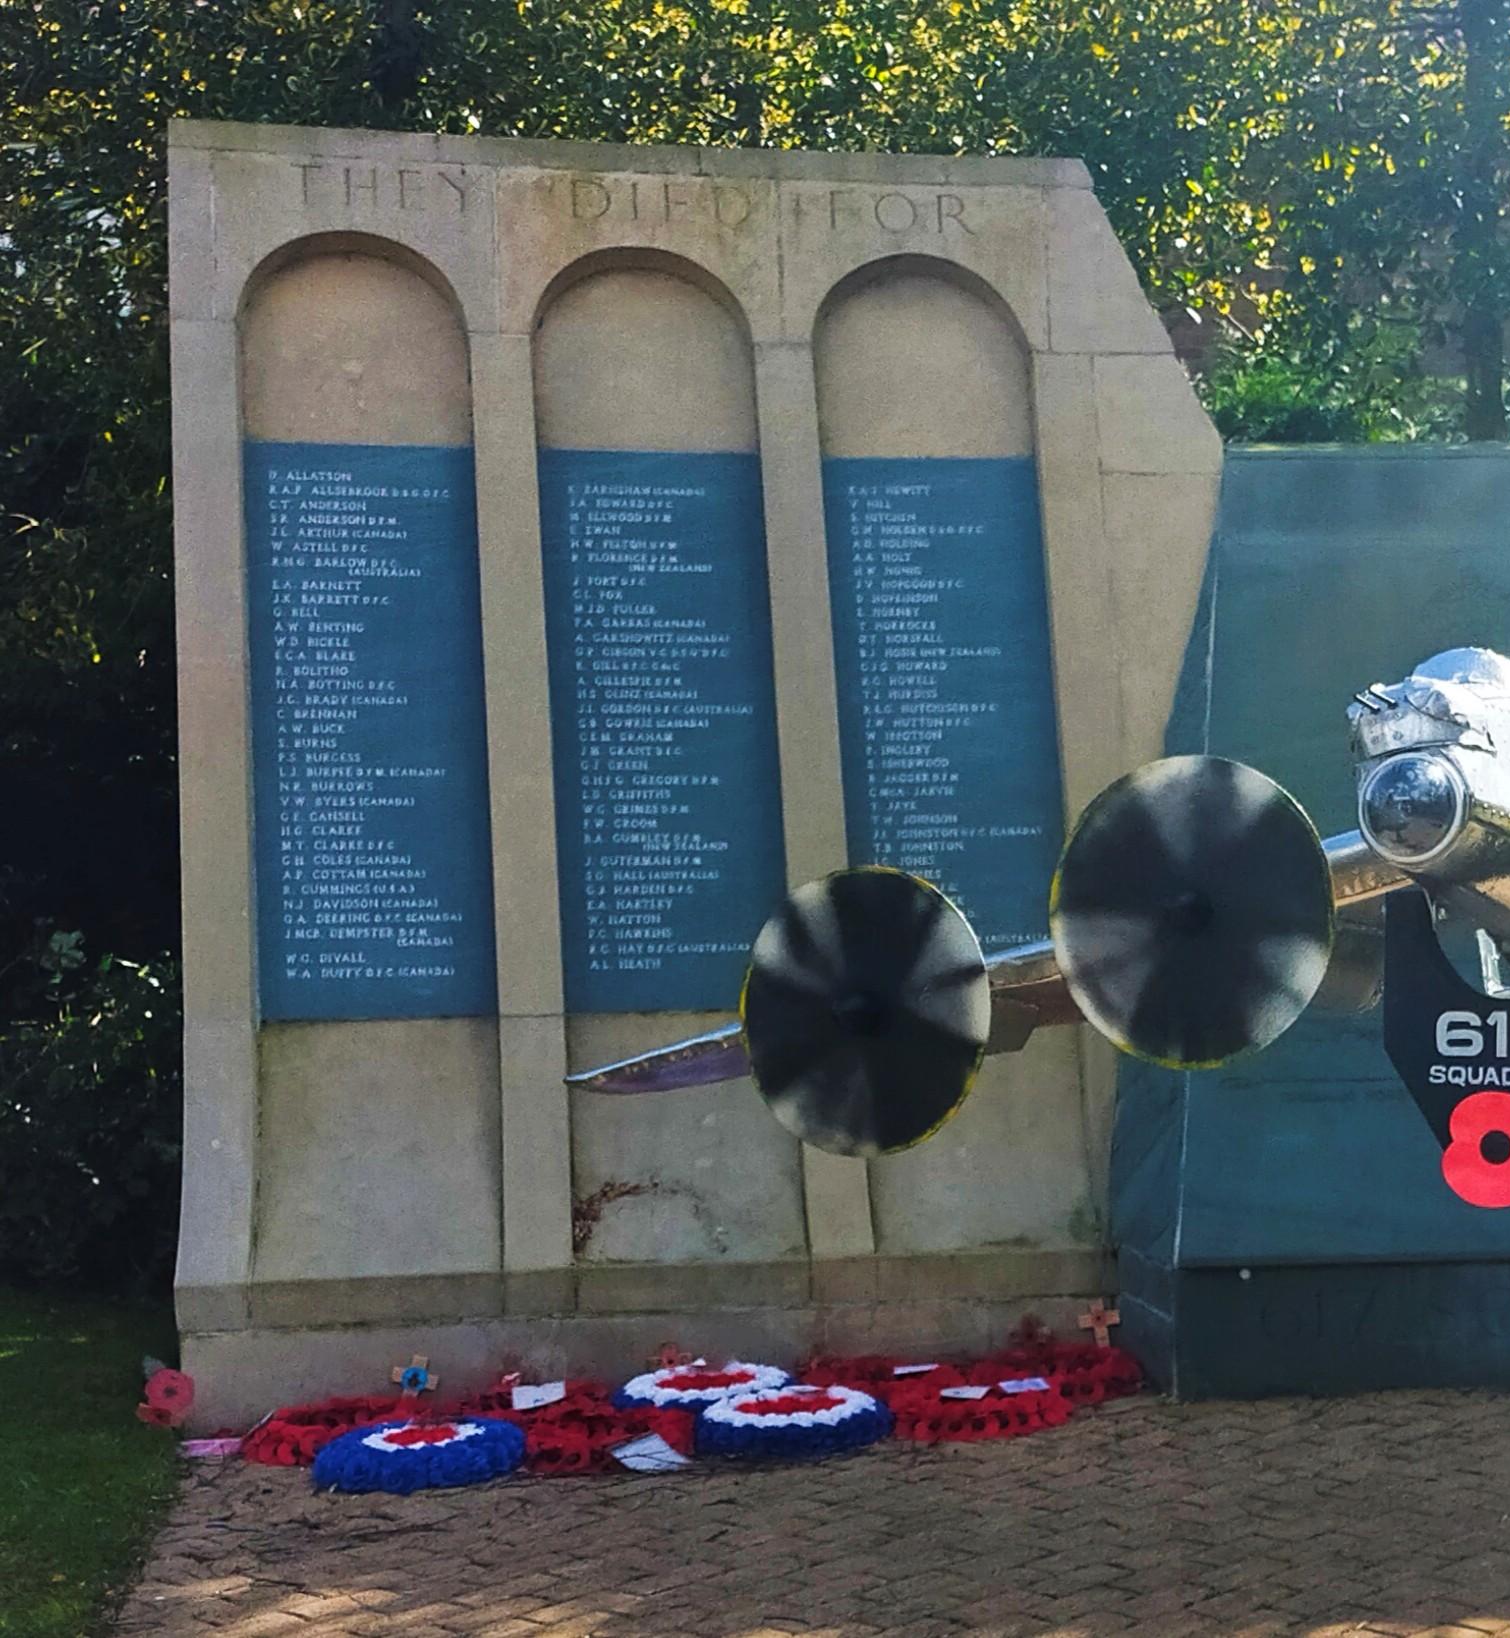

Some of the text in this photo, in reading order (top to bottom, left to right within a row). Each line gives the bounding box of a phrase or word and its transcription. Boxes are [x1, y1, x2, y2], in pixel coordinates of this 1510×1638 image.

[294, 164, 476, 212] THEY
[571, 179, 751, 228] DIED
[829, 190, 976, 236] FOR
[287, 471, 351, 481] ALLATSON
[300, 501, 366, 511] ANDERSON
[299, 515, 365, 525] ANDERSON
[298, 529, 348, 538] ARTHUR
[293, 543, 337, 552] ASTELL
[315, 559, 366, 568] BARLOW
[302, 581, 362, 590] BARNETT
[302, 595, 359, 605] BARRETT
[292, 608, 319, 617] BELL
[308, 637, 350, 647] BICKLE
[316, 651, 355, 661] BLAKE
[294, 666, 349, 676] BOLITHO
[308, 680, 364, 690] BOTTING
[305, 696, 347, 705] BRADY
[295, 710, 357, 719] BRENNAN
[312, 725, 344, 734] BUCK
[294, 739, 336, 748] BURNS
[306, 753, 360, 763] BURGESS
[310, 812, 365, 822] CANSELL
[313, 855, 351, 864] COLES
[312, 870, 366, 879] COTTAM
[301, 885, 370, 894] CUMMINGS
[314, 900, 378, 909] DAVIDSON
[316, 914, 370, 924] DEERING
[330, 929, 394, 938] DEMPSTER
[319, 953, 366, 963] DIVALL
